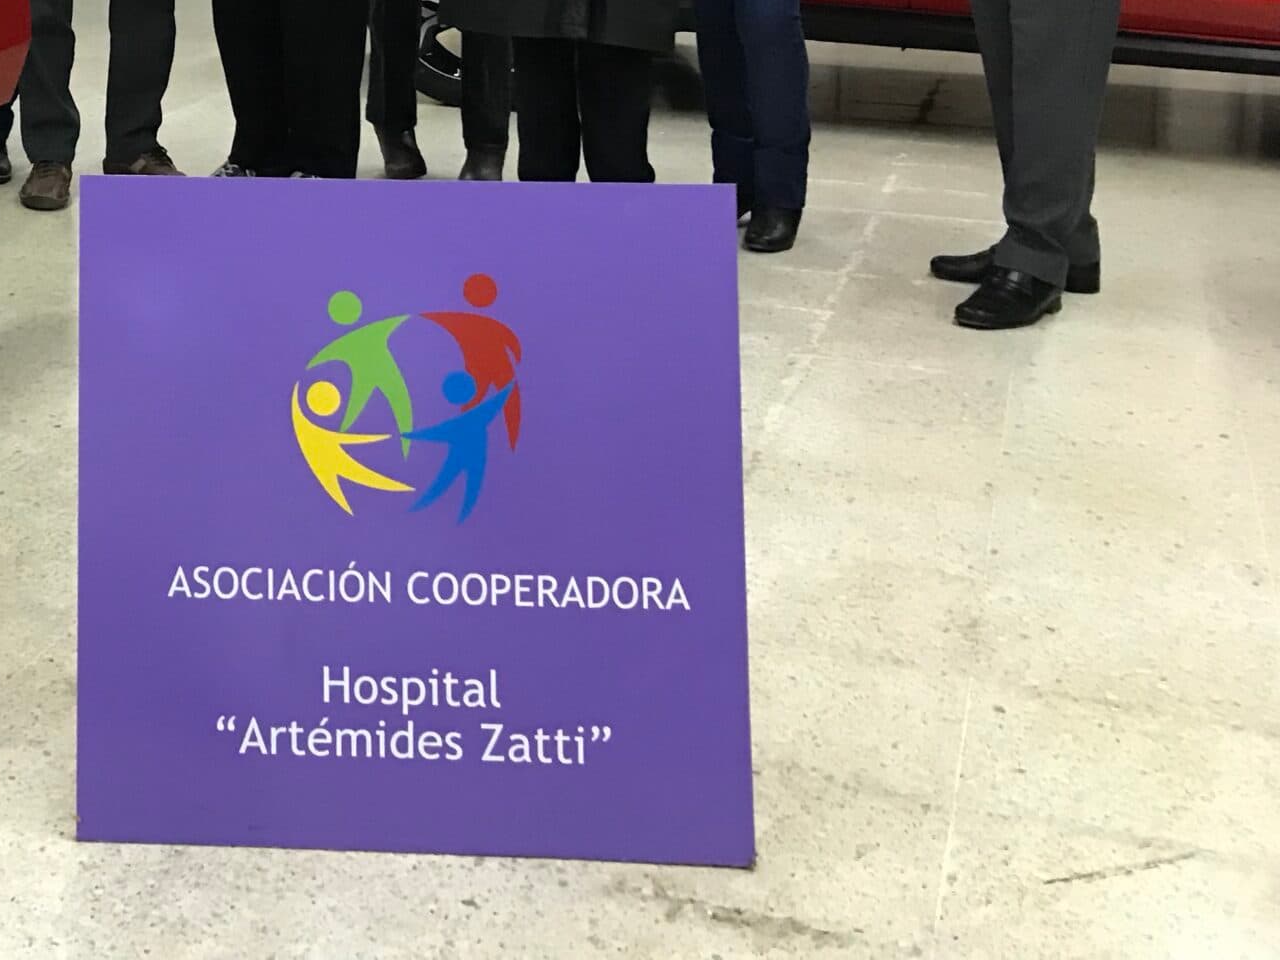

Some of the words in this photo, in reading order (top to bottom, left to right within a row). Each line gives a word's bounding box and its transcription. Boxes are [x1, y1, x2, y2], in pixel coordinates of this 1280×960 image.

[167, 560, 392, 605] ASOCIACIÓN
[406, 570, 691, 611] COOPERADORA
[322, 665, 502, 716] Hospital
[216, 715, 464, 761] “Artémides
[479, 722, 613, 765] Zatti”
